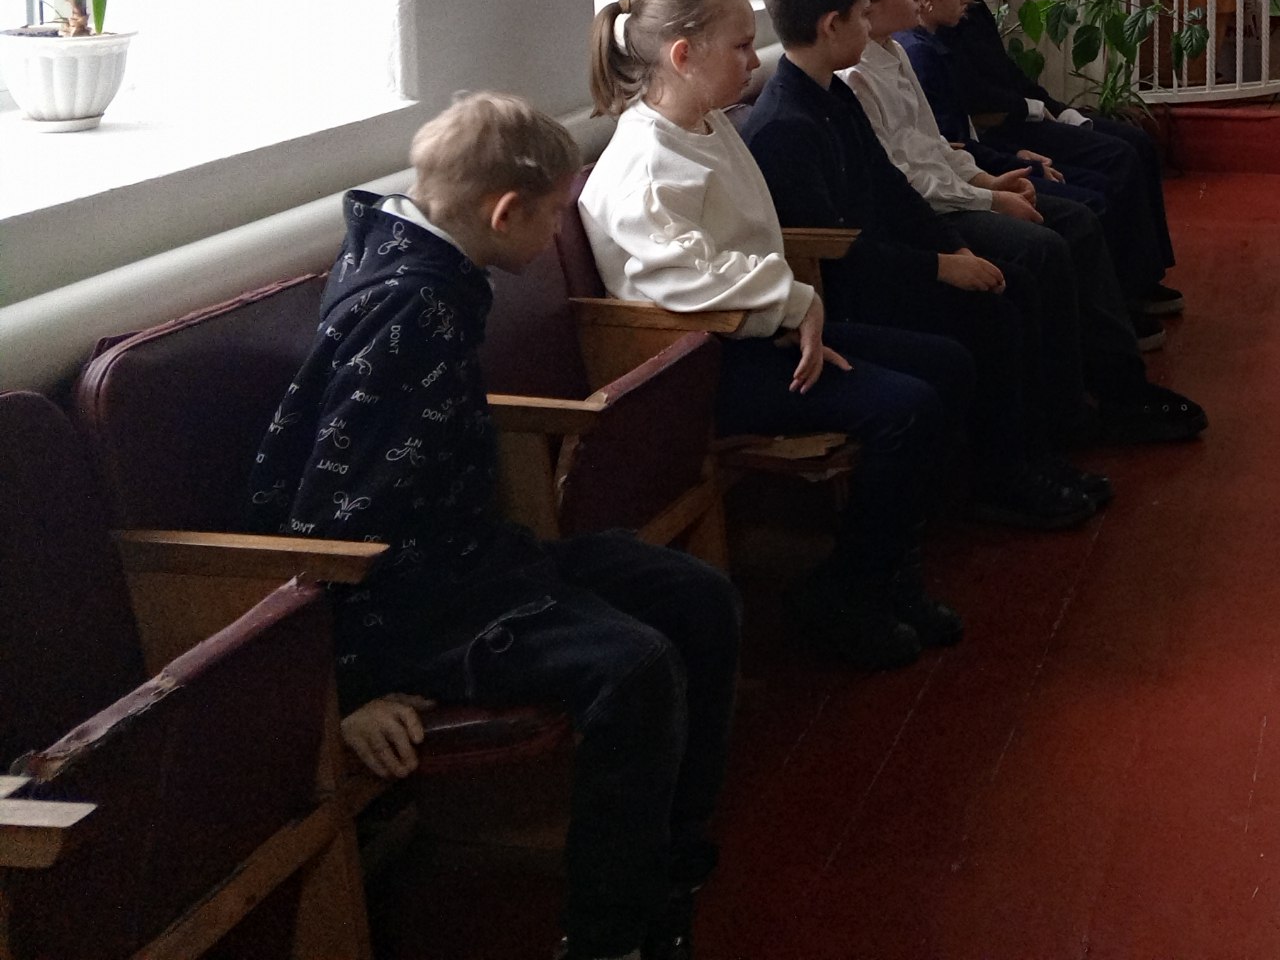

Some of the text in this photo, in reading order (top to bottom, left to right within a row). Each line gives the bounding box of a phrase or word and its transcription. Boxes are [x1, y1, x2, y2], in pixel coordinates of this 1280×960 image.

[389, 325, 401, 355] DONT
[421, 361, 448, 388] DONT
[317, 459, 350, 475] DONT
